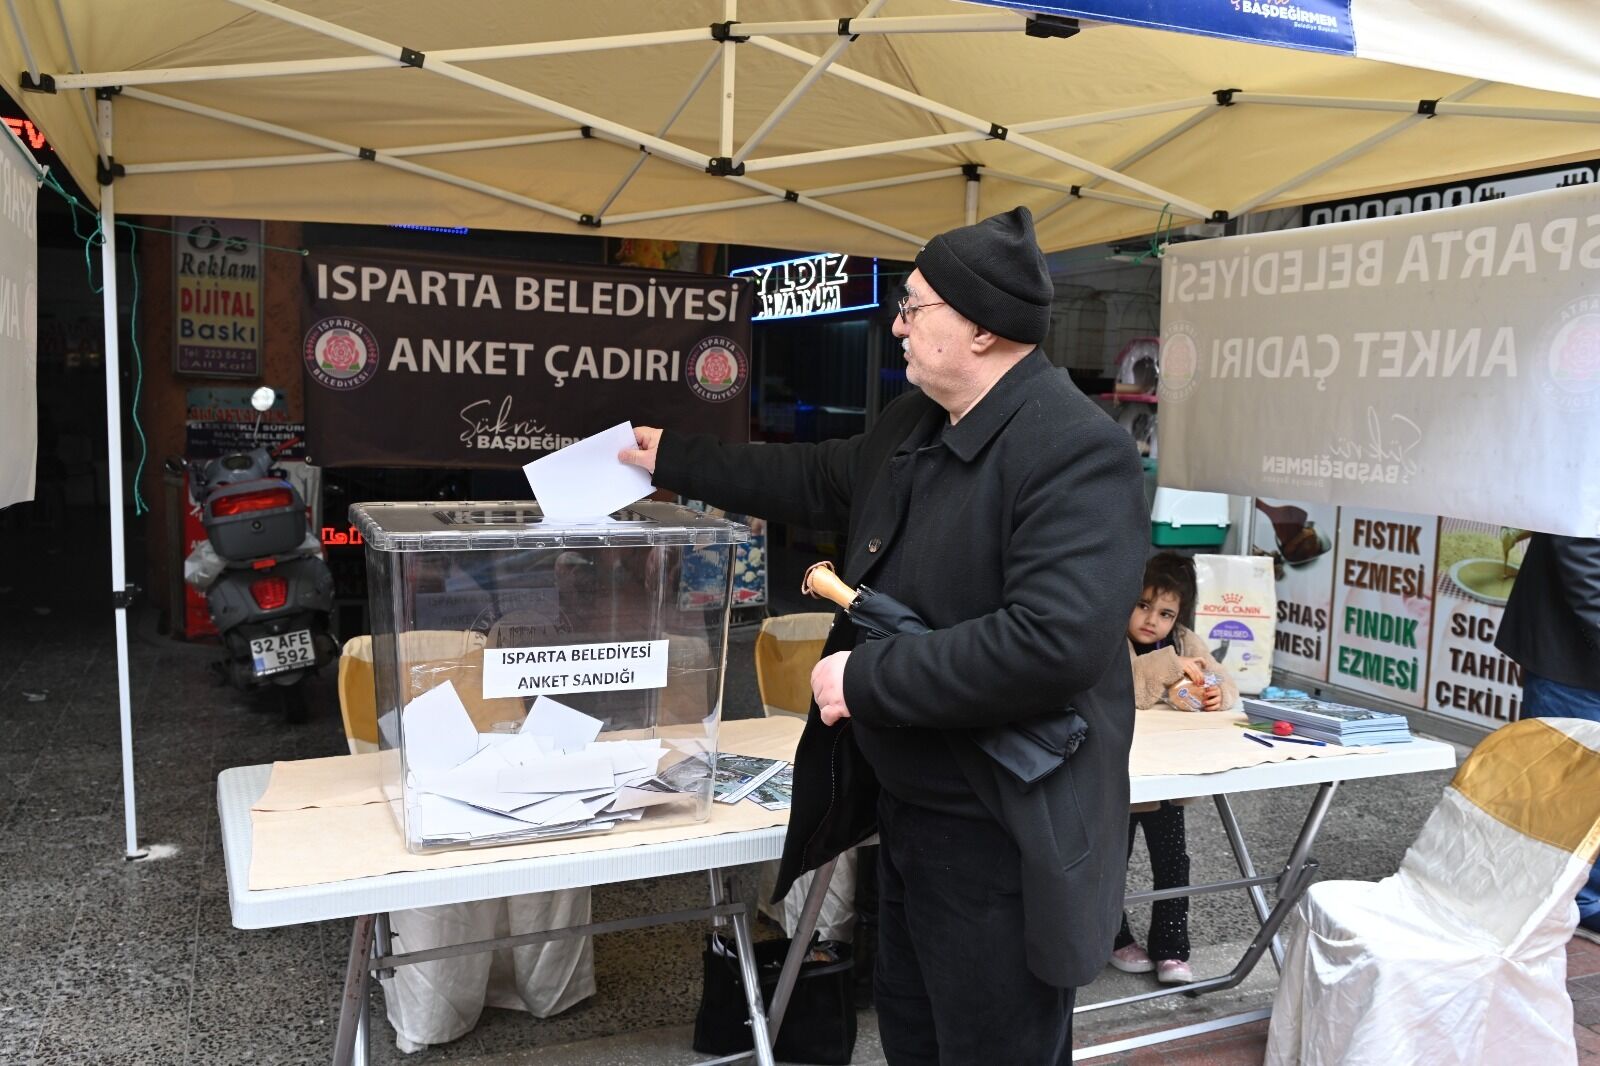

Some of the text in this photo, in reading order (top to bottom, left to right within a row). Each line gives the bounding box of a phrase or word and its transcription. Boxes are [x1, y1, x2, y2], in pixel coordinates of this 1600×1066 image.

[1243, 1, 1338, 27] BAŞDEĞİRMEN
[187, 219, 248, 253] Öz
[180, 251, 256, 279] Reklam
[180, 281, 255, 318] DİJİTAL
[317, 264, 502, 309] ISPARTA
[515, 276, 740, 322] BELEDİYESİ
[180, 318, 255, 343] Baskı
[318, 320, 363, 334] ISPARTA
[699, 339, 736, 352] ISPARTA
[313, 368, 369, 387] BELEDİYESİ
[387, 337, 680, 388] ANKET ÇADIRI
[693, 383, 740, 400] BELEDİYESİ
[459, 395, 546, 448] Şükrü
[477, 433, 584, 452] BAŞDEĞİR
[1353, 518, 1422, 556] FISTIK
[1343, 558, 1425, 599] EZMESİ
[1203, 604, 1261, 615] ROYAL CANIN
[1276, 600, 1327, 633] ŞHAŞ
[253, 631, 310, 655] 32 AFE
[1344, 606, 1419, 650] FINDIK
[1451, 612, 1496, 645] SIC
[277, 648, 309, 665] 592
[502, 643, 651, 665] ISPARTA BELEDİYESİ
[1275, 629, 1322, 662] MESİ
[517, 668, 635, 690] ANKET SANDIĞI
[1338, 645, 1419, 693] EZMESİ
[1449, 646, 1524, 688] TAHİN
[1435, 680, 1518, 722] ÇEKİLİ
